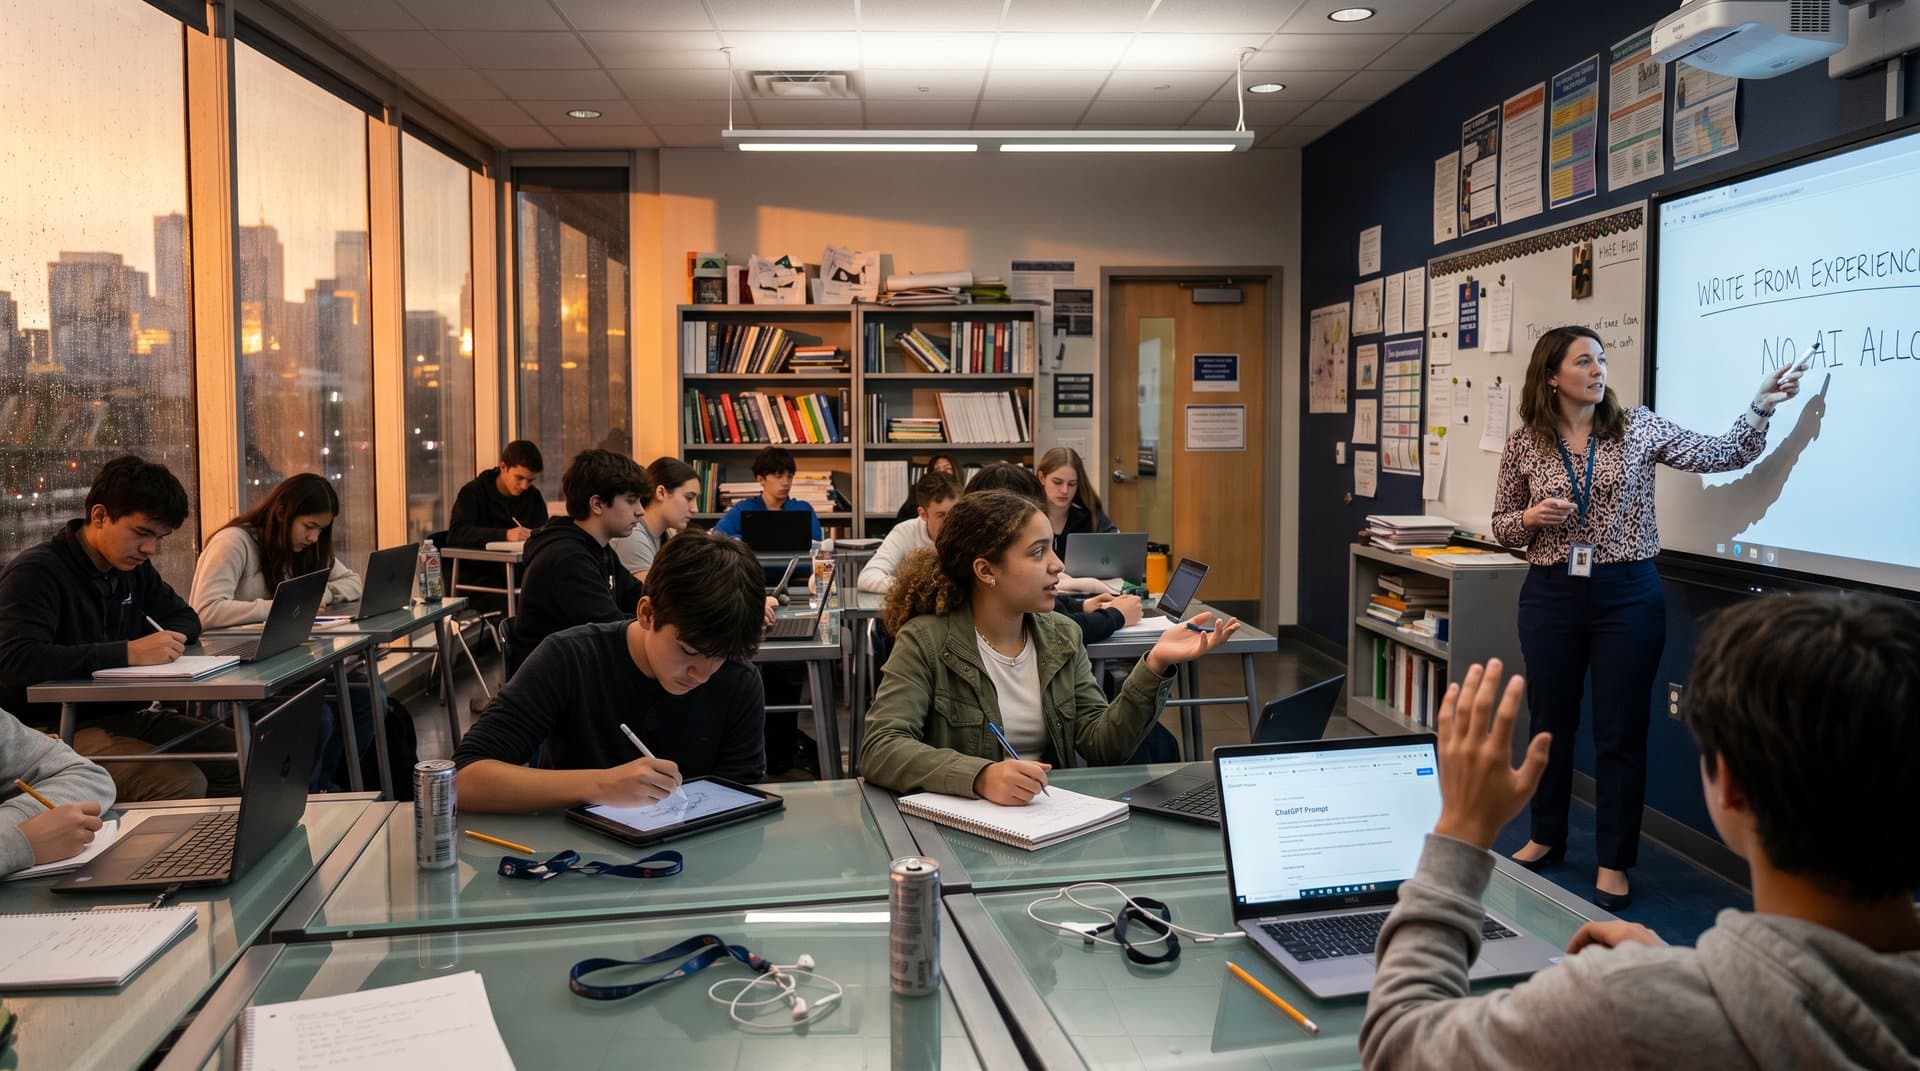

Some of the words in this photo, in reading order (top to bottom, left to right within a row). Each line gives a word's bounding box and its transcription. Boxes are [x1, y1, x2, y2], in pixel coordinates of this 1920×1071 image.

[1697, 273, 1745, 307] WRITE
[1752, 264, 1801, 298] FROM
[1811, 247, 1920, 288] EXPERIENC
[1761, 335, 1796, 375] NO
[1810, 329, 1844, 370] AI
[1274, 807, 1303, 816] ChatGPT
[1304, 805, 1329, 815] Prompt
